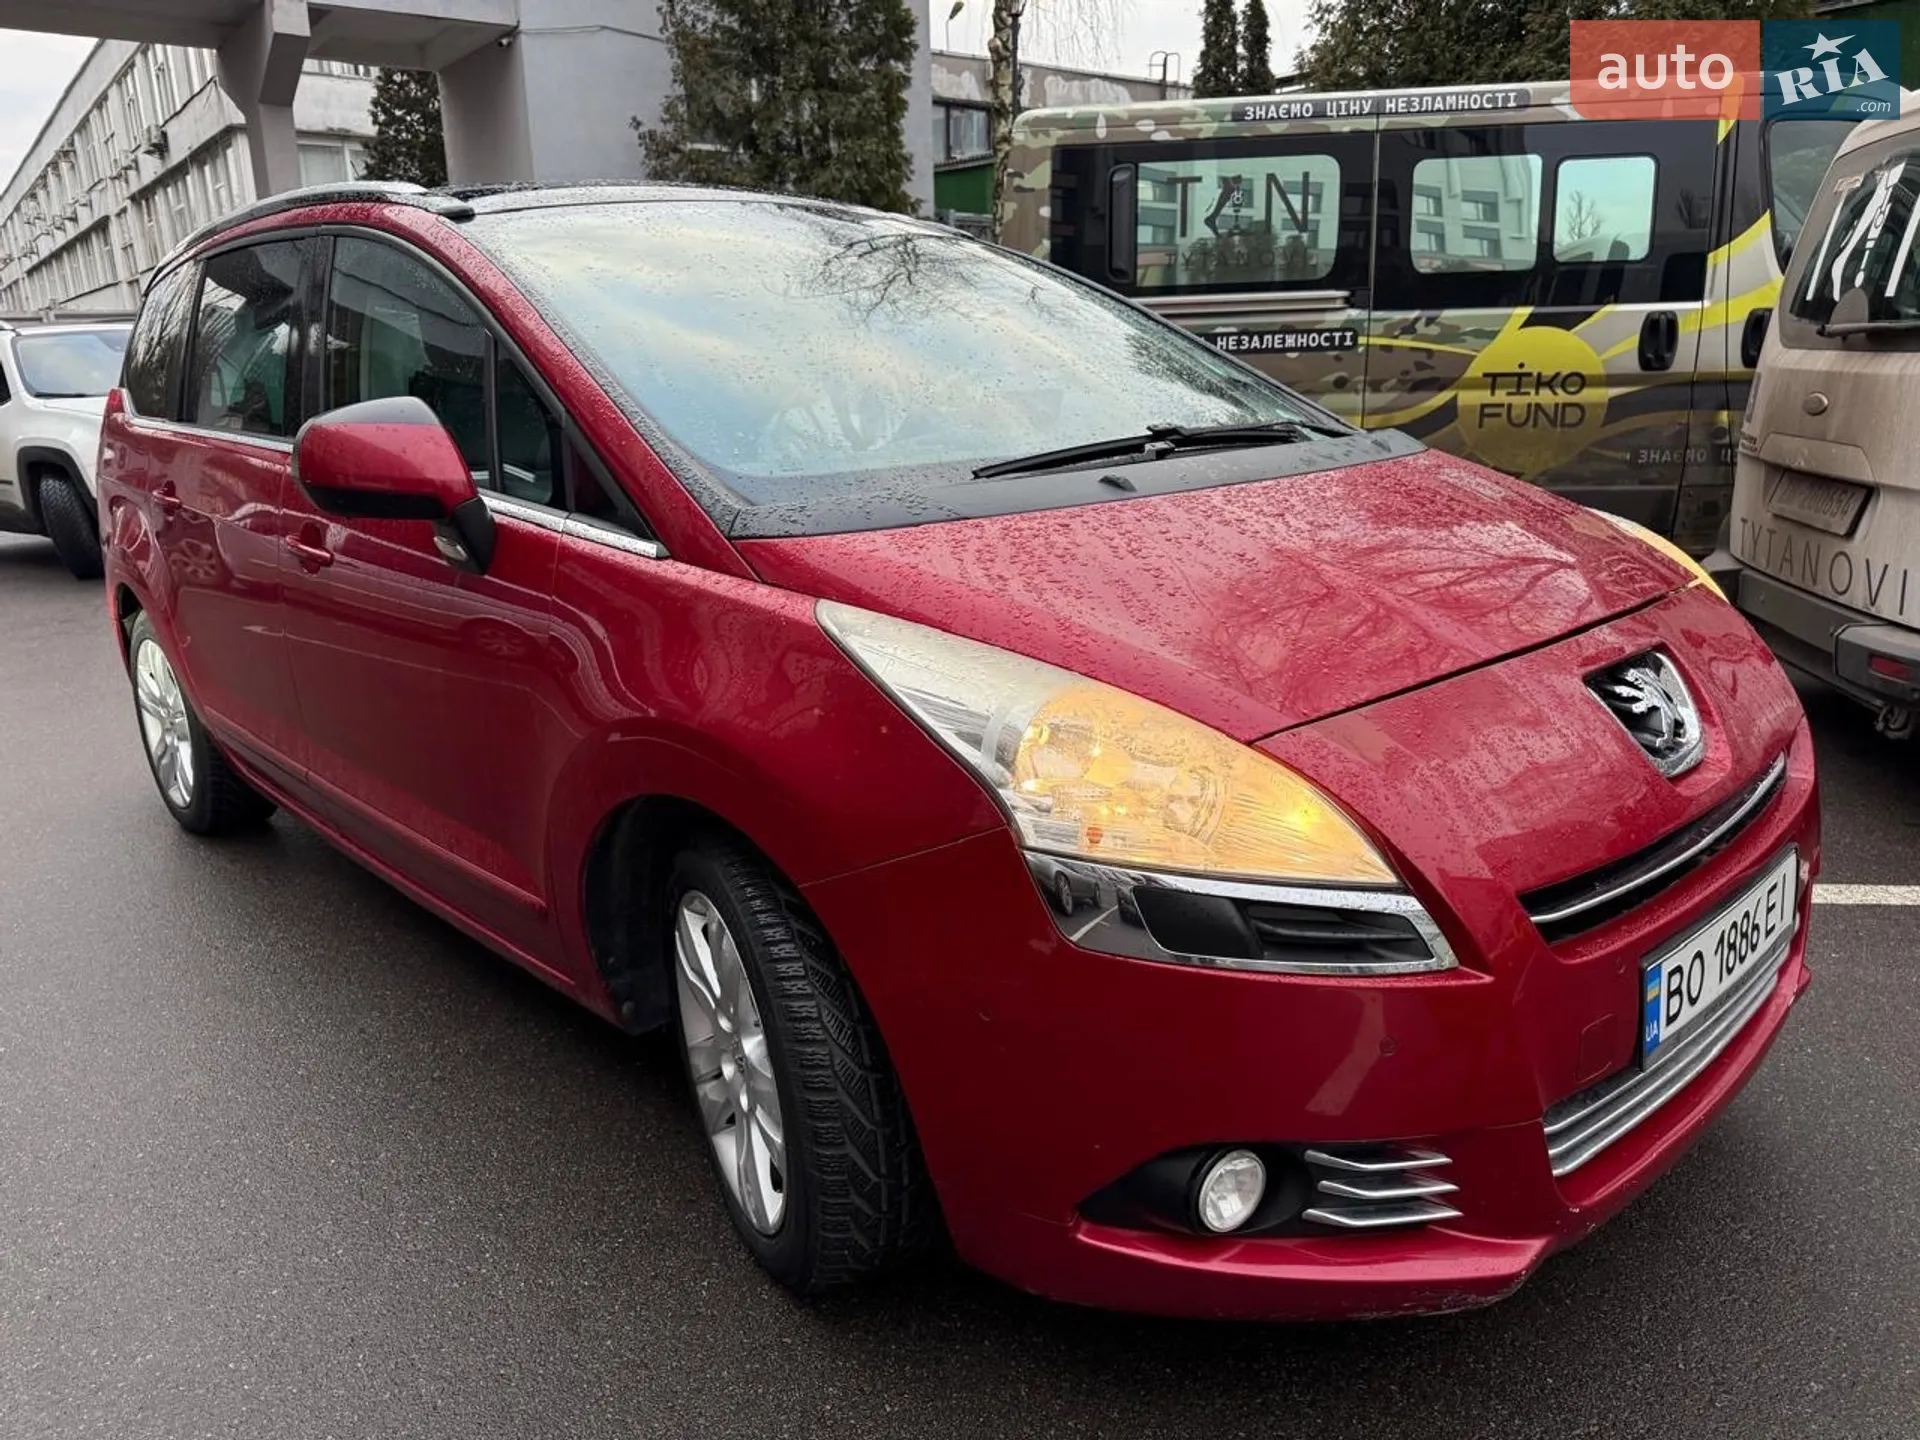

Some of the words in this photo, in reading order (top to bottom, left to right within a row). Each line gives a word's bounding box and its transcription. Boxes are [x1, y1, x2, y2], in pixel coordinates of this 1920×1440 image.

[1243, 102, 1313, 121] ЗНАЄМО
[1325, 99, 1373, 119] ЦІНУ
[1385, 92, 1518, 113] НЕЗЛАМНОСТІ
[1216, 332, 1353, 350] НЕЗАЛЕЖНОСТІ
[1478, 402, 1586, 429] FUND
[1740, 517, 1908, 616] TYTANOVI
[1665, 950, 1705, 1027] BO
[1714, 897, 1762, 984] 1886
[1765, 872, 1787, 938] EI
